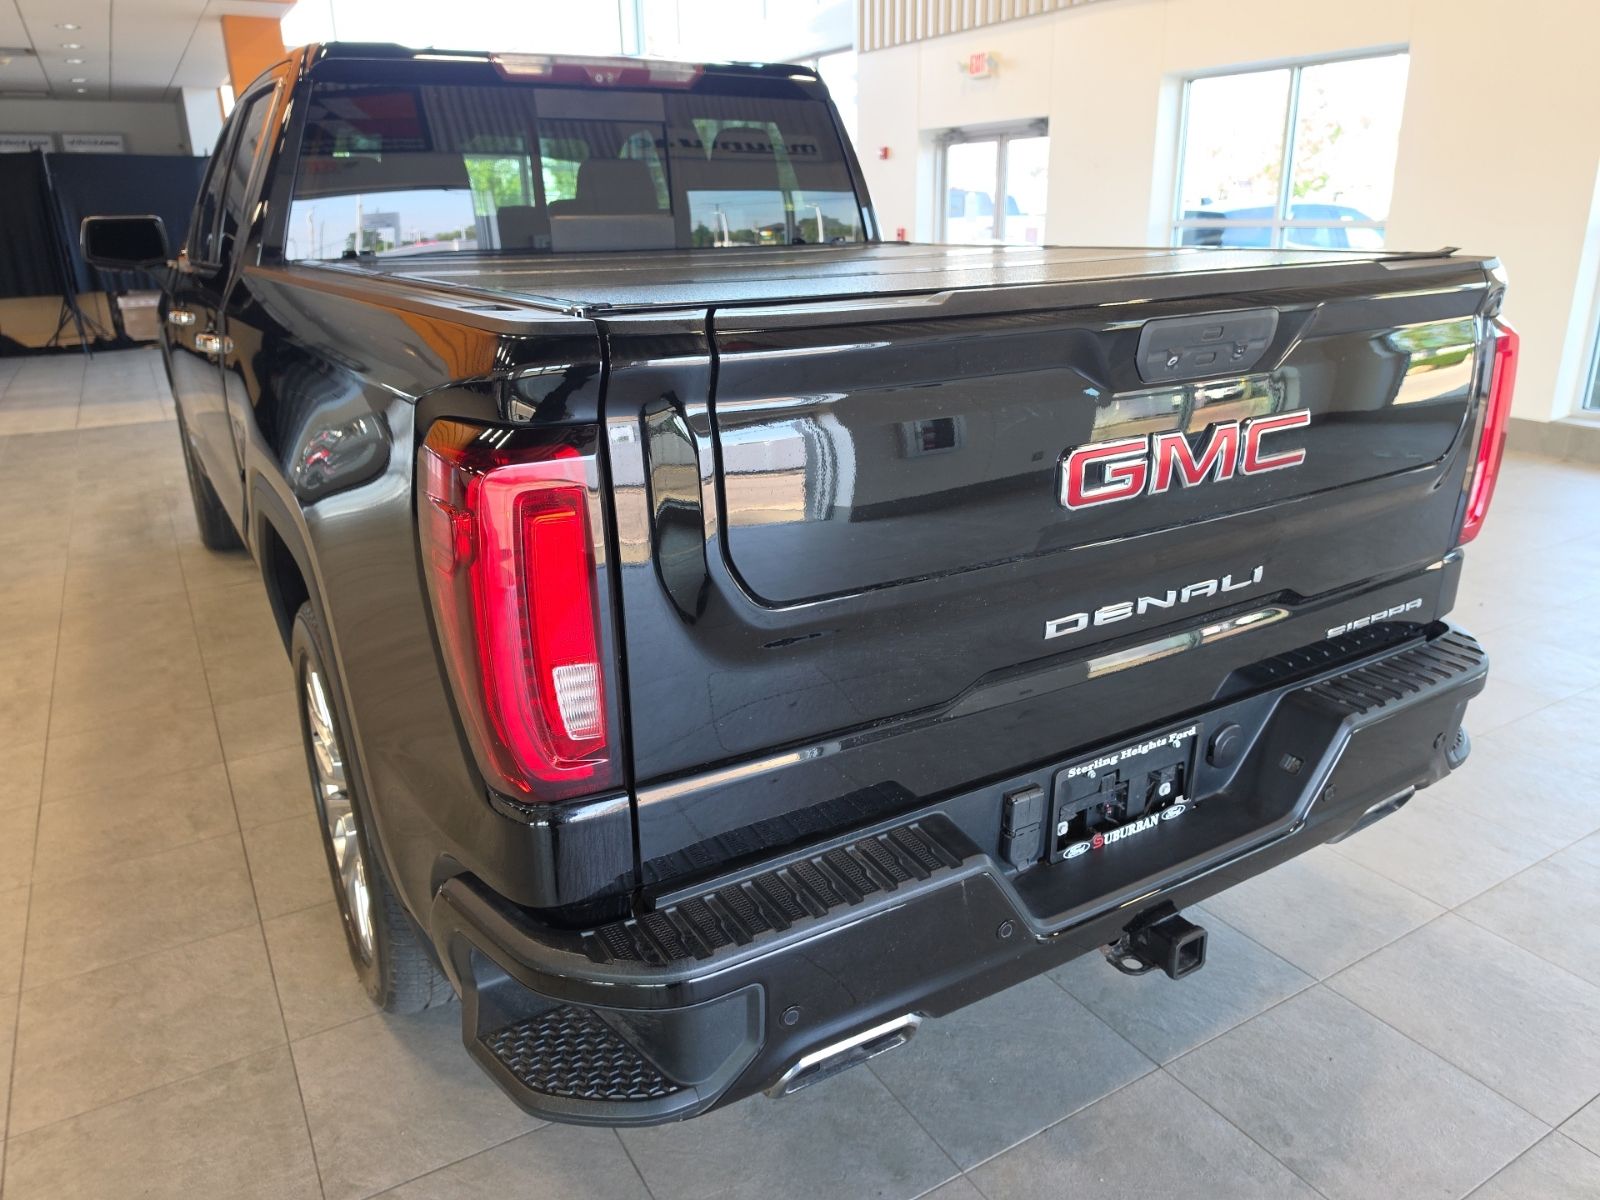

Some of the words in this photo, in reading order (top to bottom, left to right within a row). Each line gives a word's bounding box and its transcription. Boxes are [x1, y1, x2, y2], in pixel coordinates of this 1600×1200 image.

[1060, 408, 1311, 510] GMC
[1043, 565, 1264, 640] DENALI
[1326, 597, 1423, 639] SIERRA
[1067, 754, 1119, 778] Sterling
[1120, 739, 1167, 760] Heights
[1168, 726, 1196, 743] Ford
[1066, 844, 1088, 858] Ford
[1093, 813, 1160, 849] SUBURBAN
[1163, 805, 1184, 819] Ford
